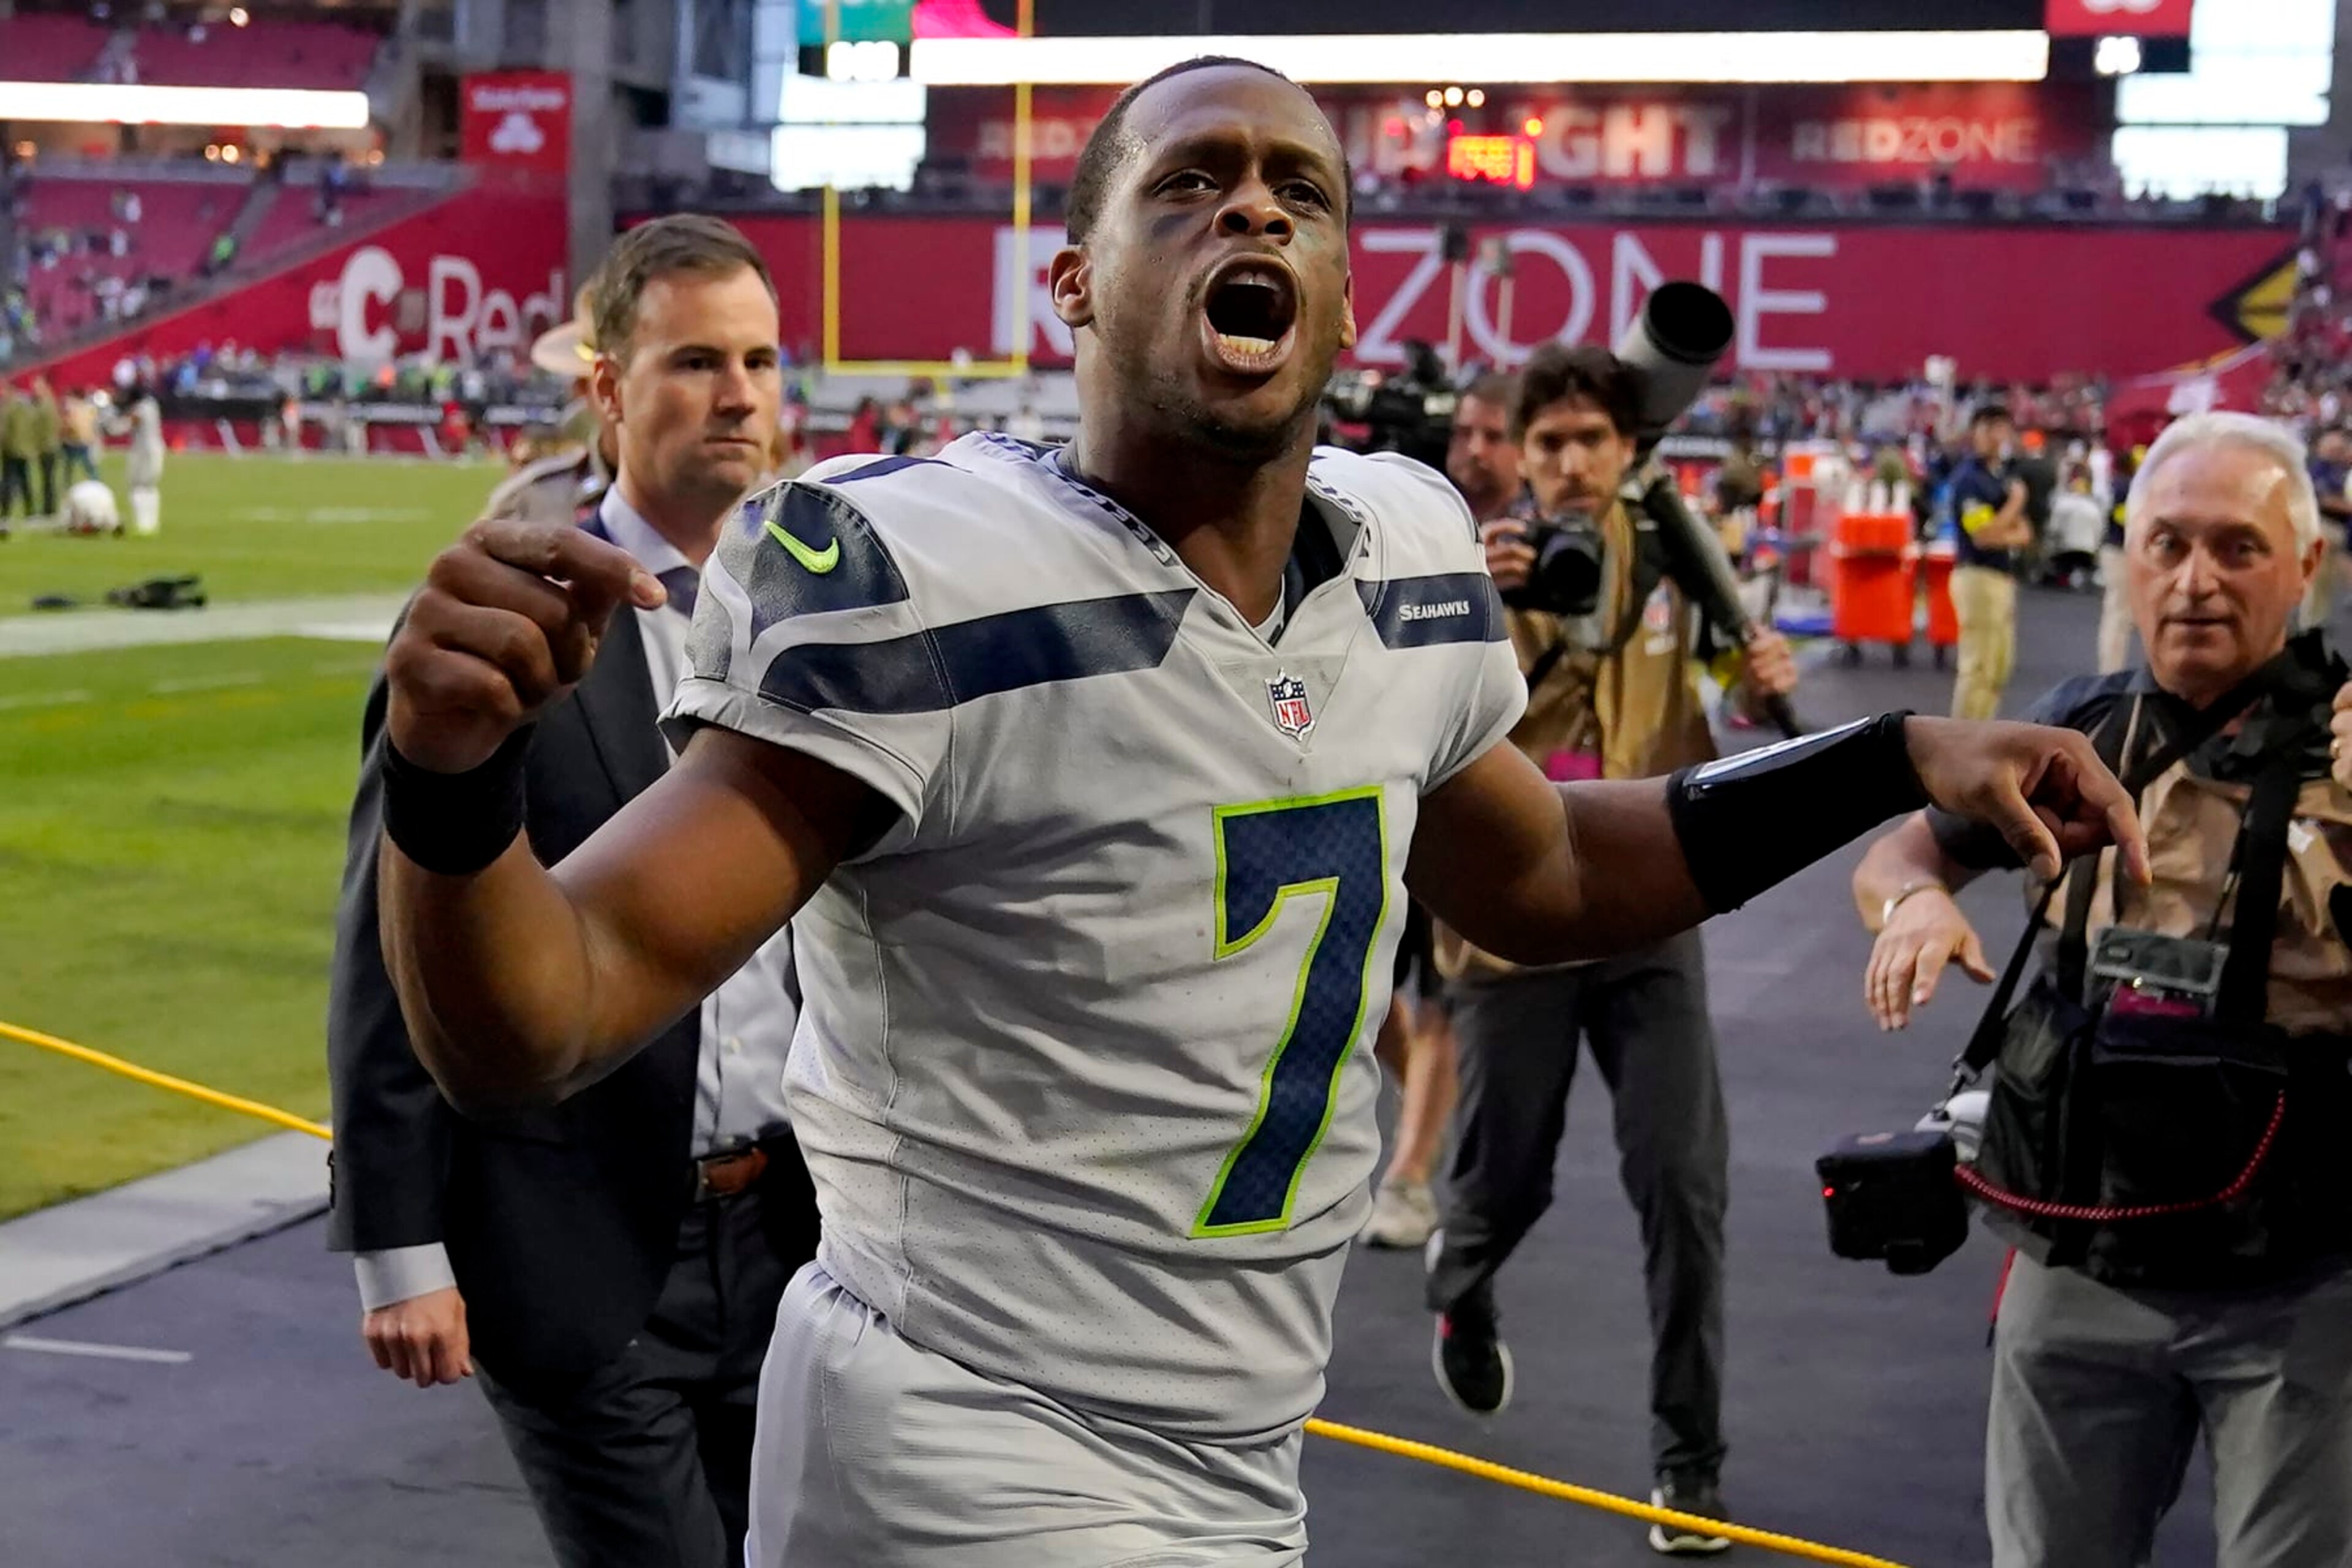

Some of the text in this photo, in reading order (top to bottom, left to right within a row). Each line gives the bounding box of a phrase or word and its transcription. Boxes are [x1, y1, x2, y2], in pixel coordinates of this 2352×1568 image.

[1354, 228, 1837, 371] ZONE
[1398, 600, 1471, 622] SEAHAWKS
[1278, 699, 1309, 726] NFL
[1189, 785, 1390, 1239] 7
